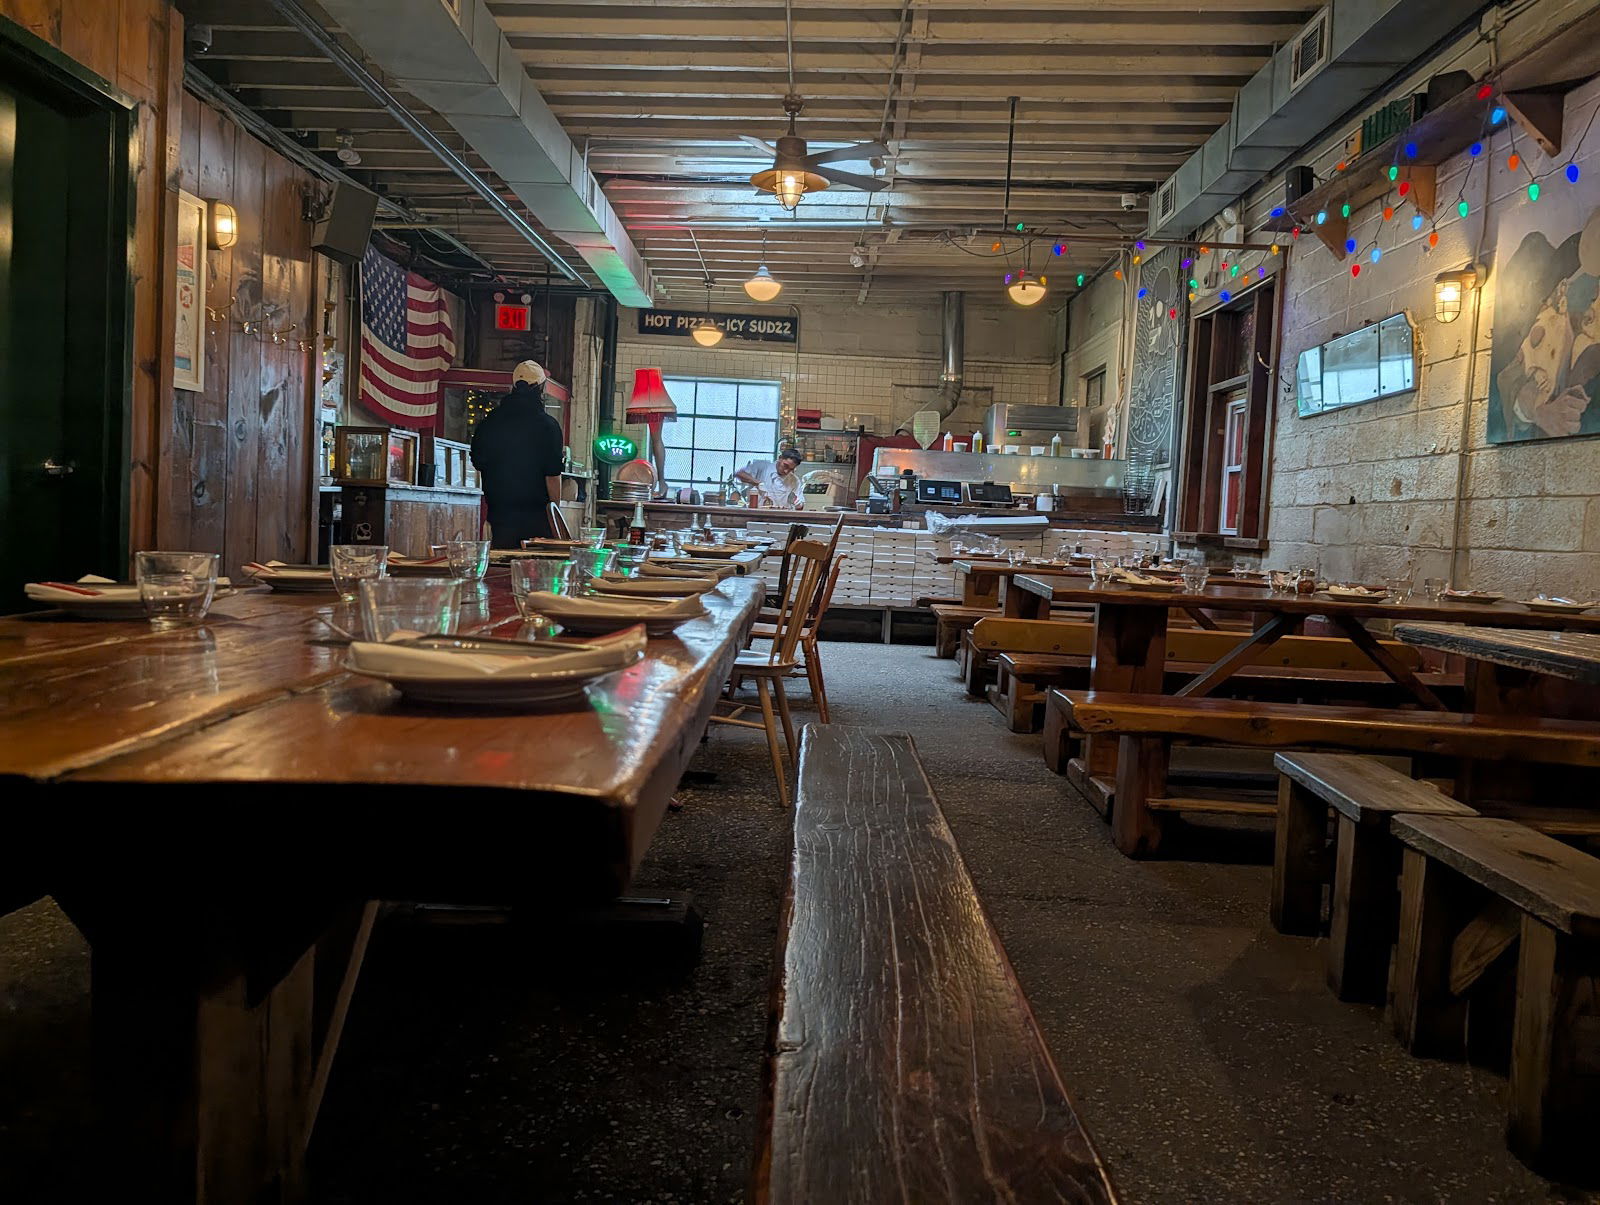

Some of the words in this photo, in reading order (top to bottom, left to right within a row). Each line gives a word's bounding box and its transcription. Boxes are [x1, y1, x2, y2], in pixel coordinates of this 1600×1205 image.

[645, 314, 673, 327] HOT
[726, 318, 747, 332] ICY
[599, 438, 633, 454] PIZZA
